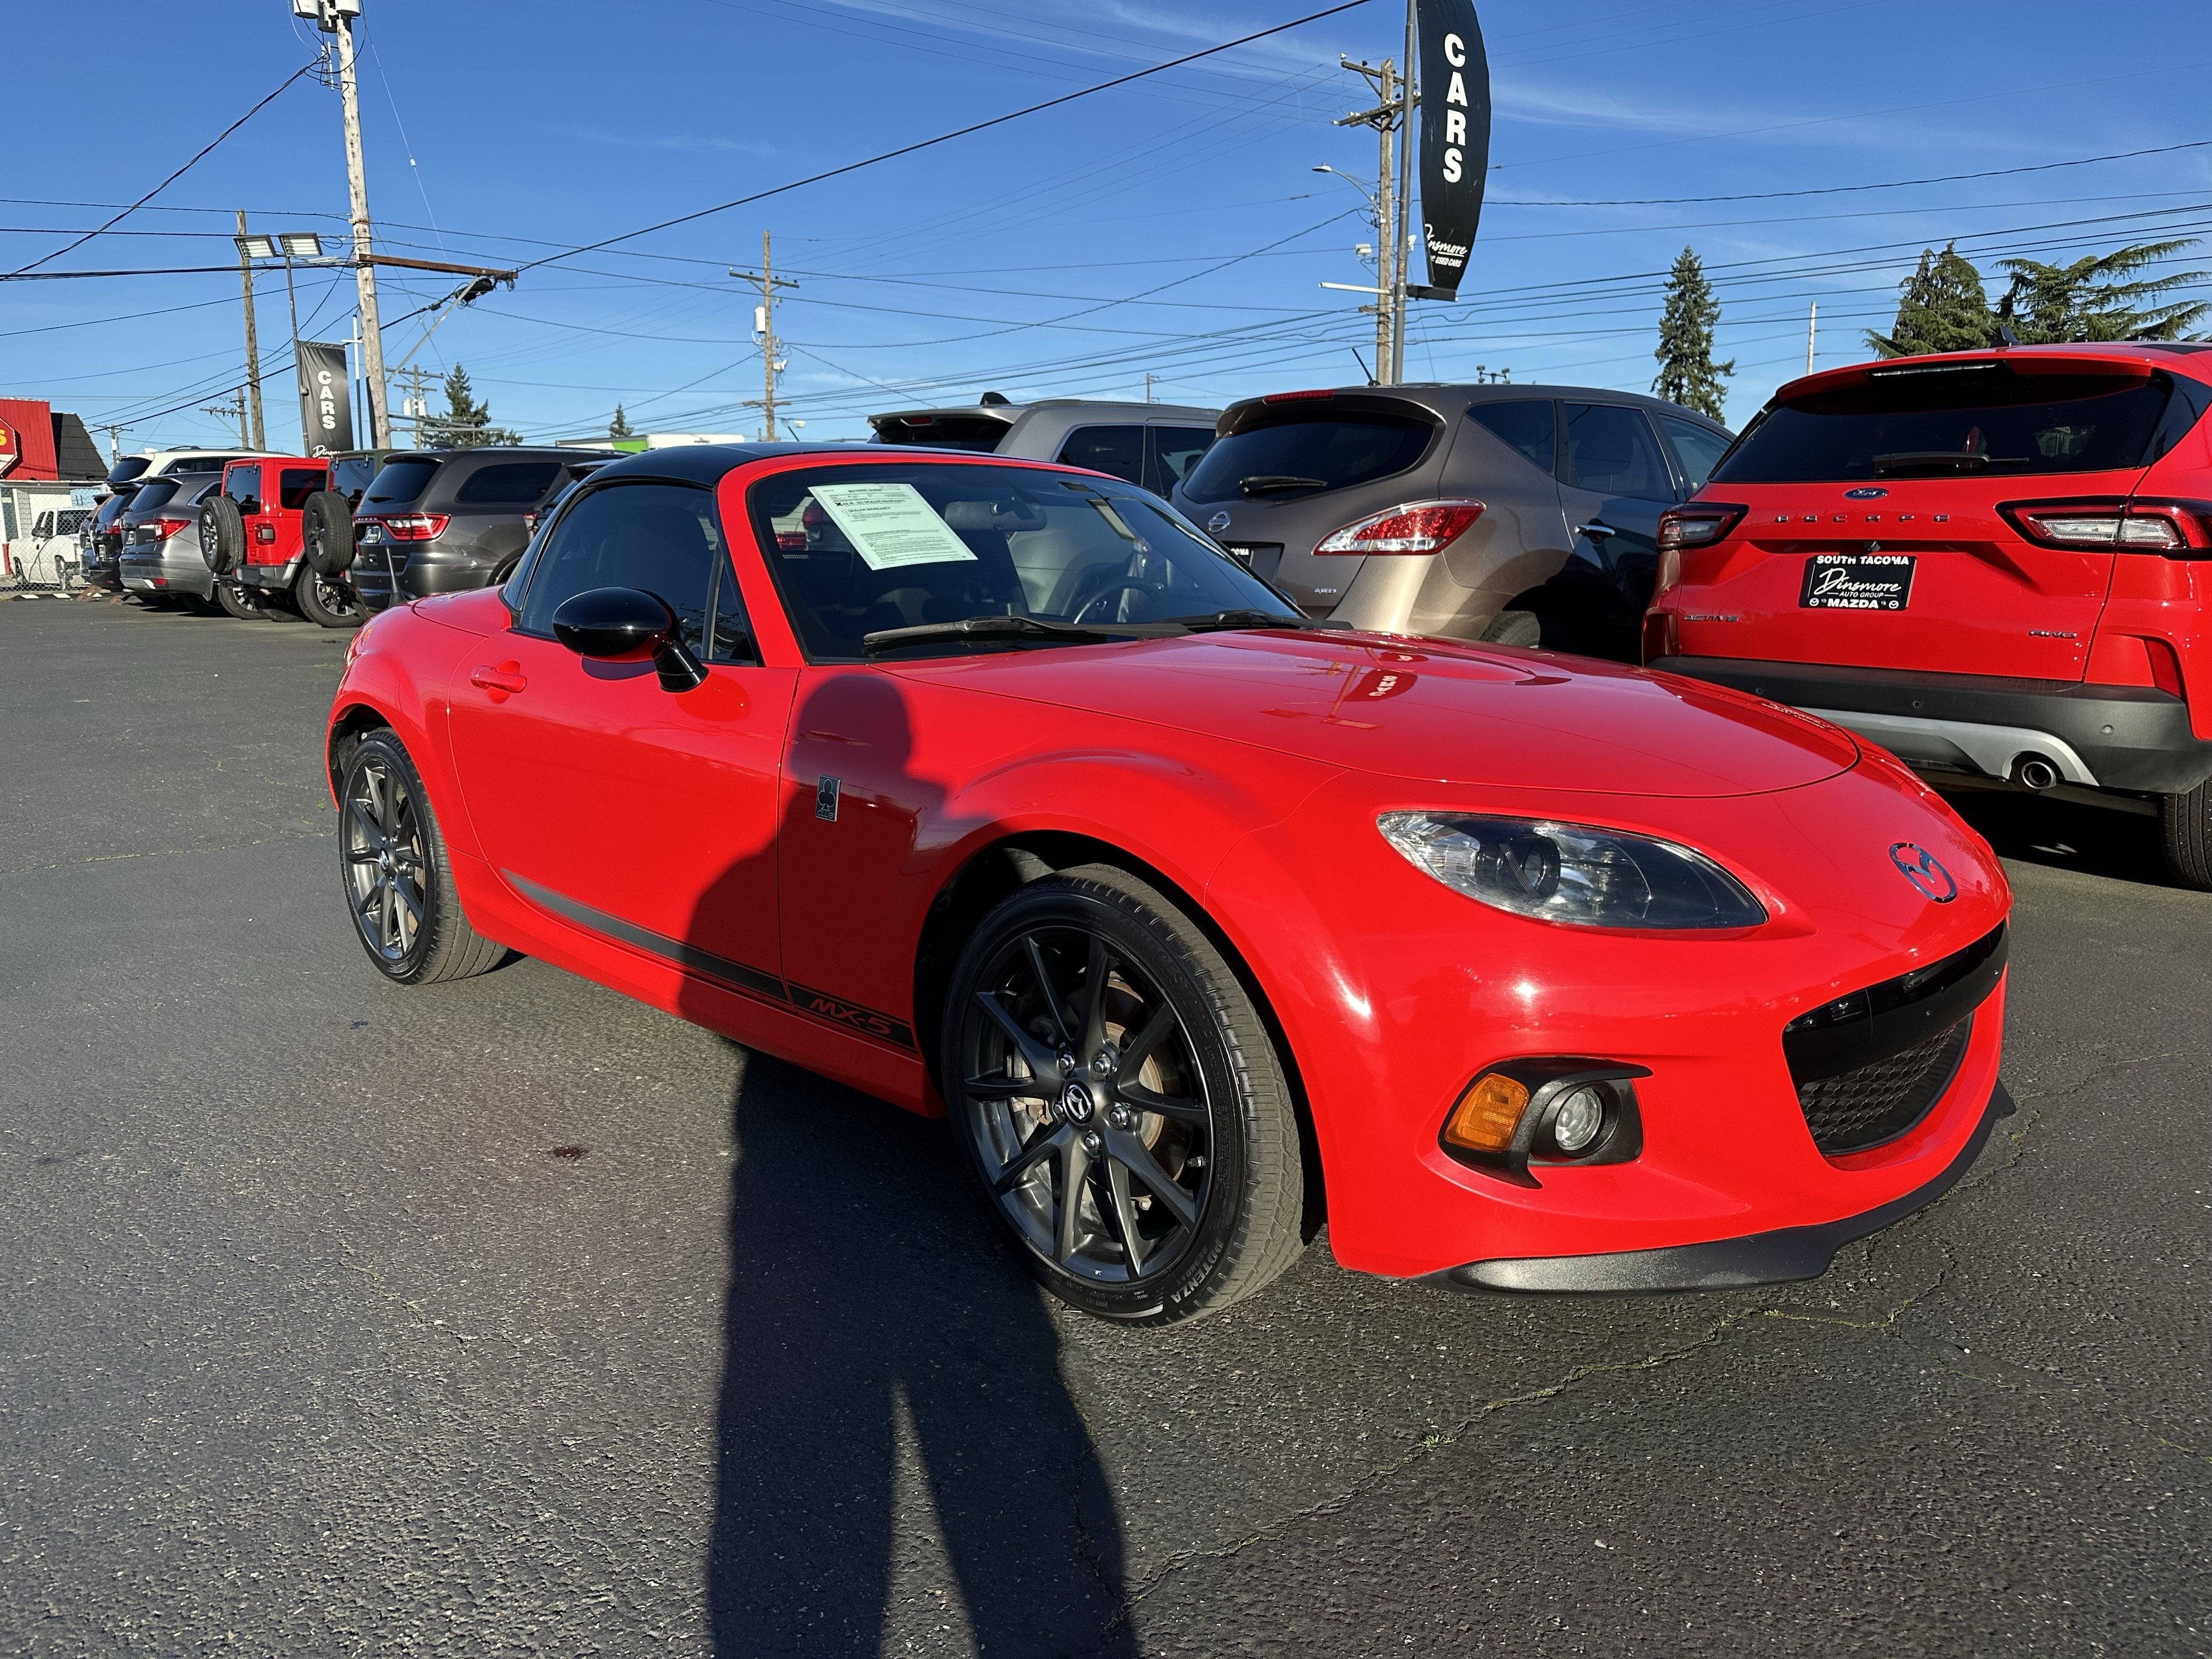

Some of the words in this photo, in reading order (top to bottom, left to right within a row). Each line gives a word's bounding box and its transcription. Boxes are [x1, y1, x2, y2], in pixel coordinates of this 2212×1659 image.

[1443, 32, 1468, 183] CARS
[317, 370, 336, 430] CARS
[1816, 555, 1857, 565] SOUTH
[1860, 556, 1909, 565] TACOMA
[1814, 567, 1902, 595] Dinsmore
[1827, 598, 1879, 609] MAZDA
[817, 809, 834, 819] CLUB
[810, 998, 892, 1035] MX-5
[1170, 1237, 1224, 1304] POTENZA
